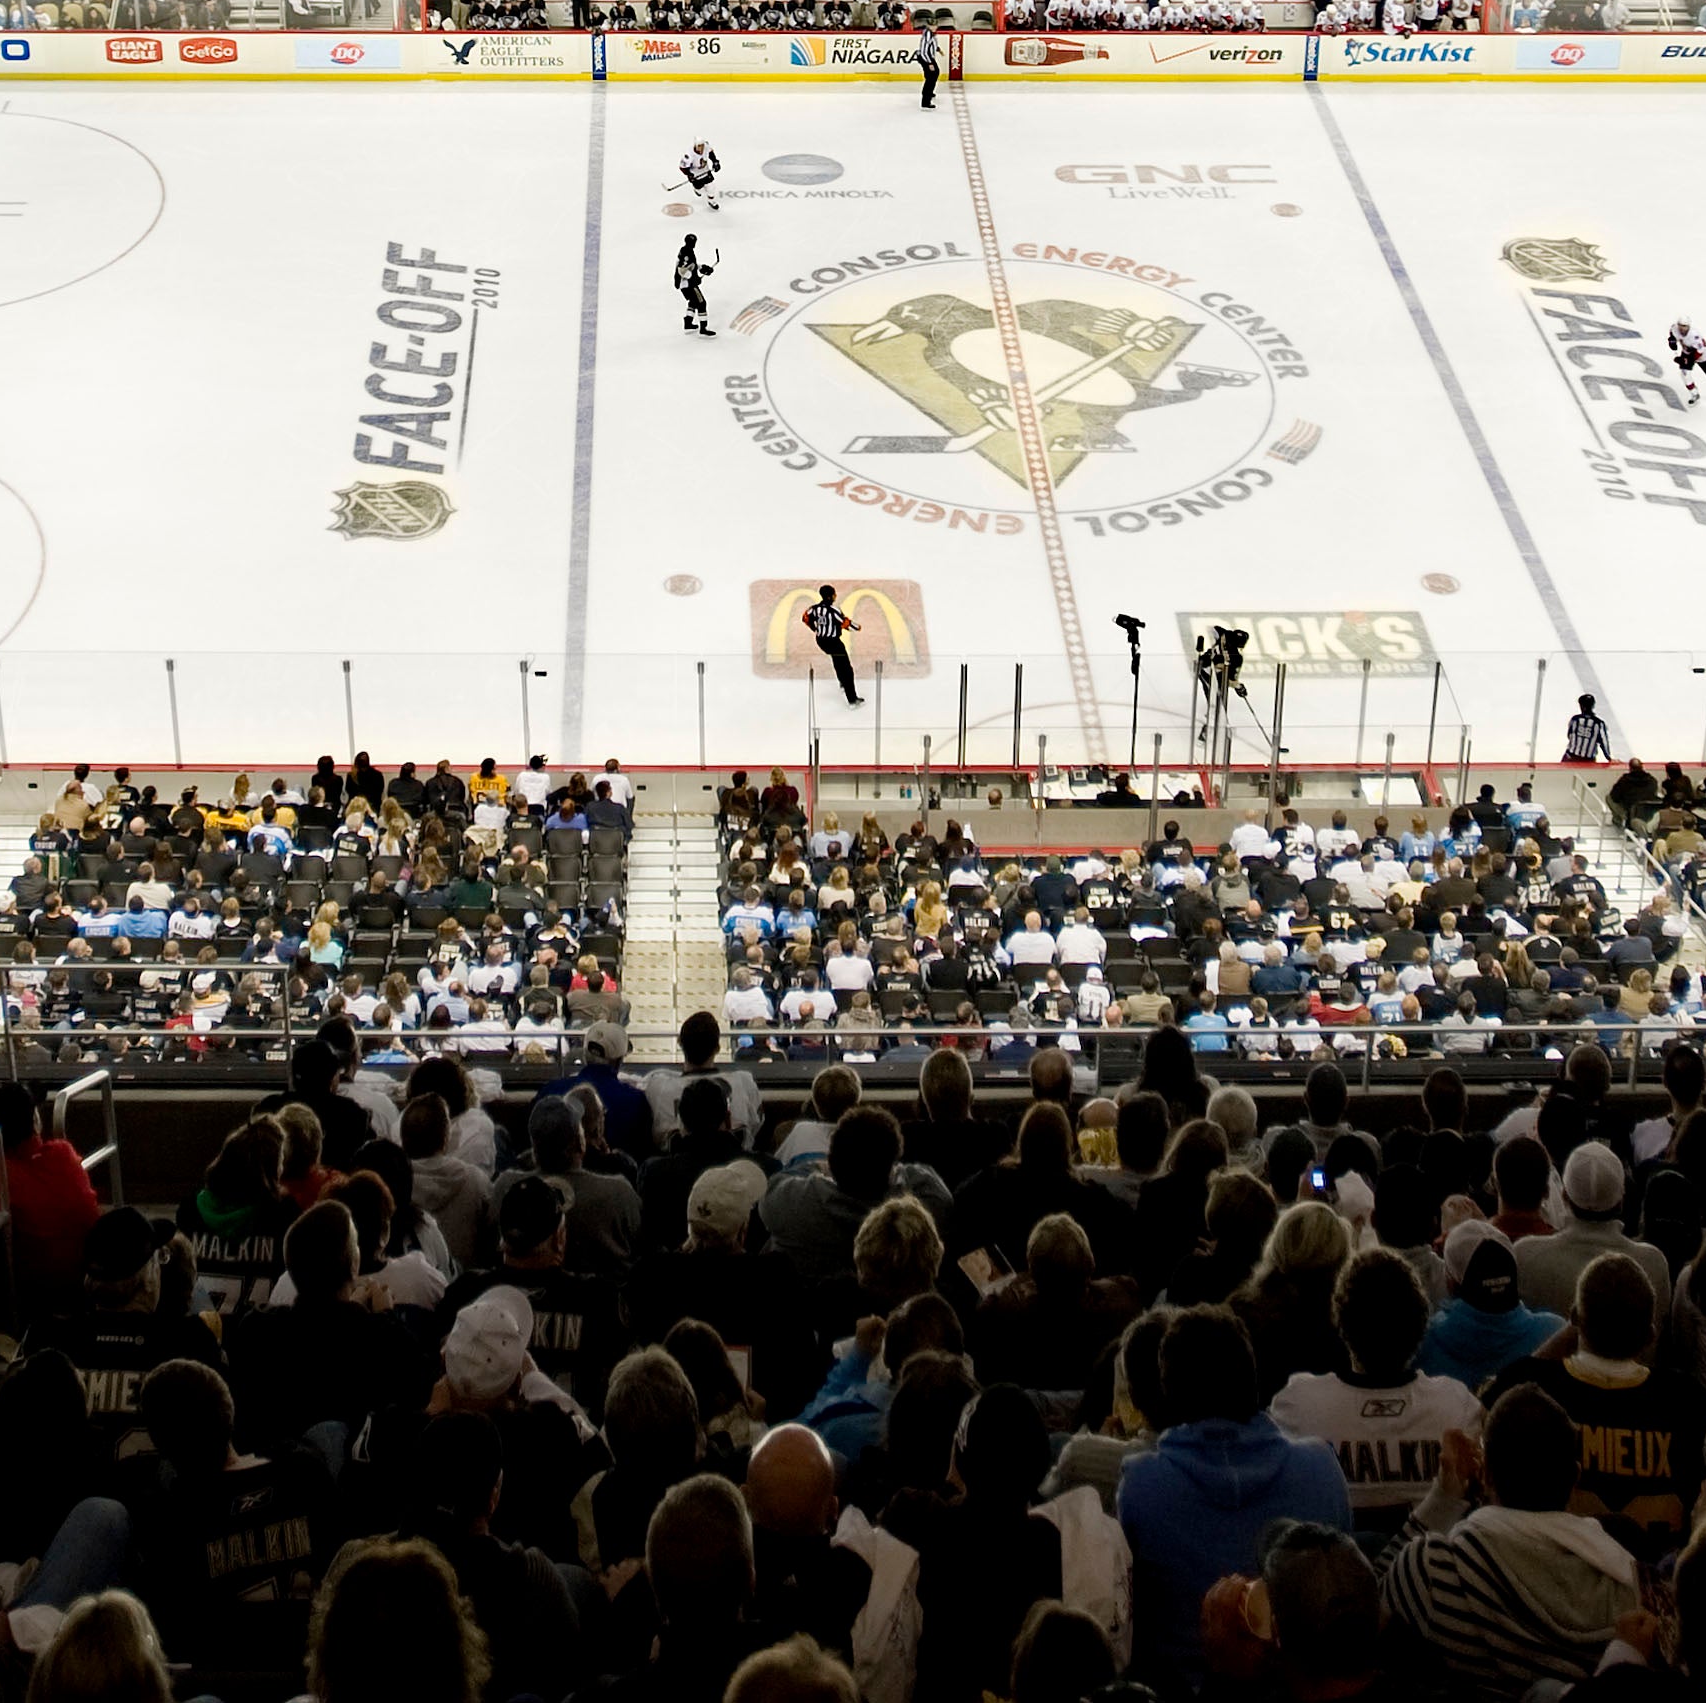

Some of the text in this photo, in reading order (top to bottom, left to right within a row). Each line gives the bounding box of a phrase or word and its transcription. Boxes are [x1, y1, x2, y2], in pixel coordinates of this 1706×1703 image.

[109, 40, 157, 52] GIANT
[480, 36, 553, 46] AMERICAN
[833, 38, 871, 48] FIRST
[111, 49, 157, 61] EAGLE
[181, 43, 235, 60] GetGo
[480, 46, 524, 57] EAGLE
[831, 49, 921, 65] NIAGARA
[1208, 46, 1283, 64] verizon
[1362, 41, 1476, 63] StarKist
[480, 56, 565, 67] OUTFITTERS
[1054, 164, 1278, 186] GNC
[801, 188, 895, 202] MINOLTA
[472, 265, 504, 311] 2010
[789, 240, 1314, 384] CONSOL ENERGY CENTER
[353, 241, 472, 476] FACE-OFF
[725, 373, 1276, 536] CONSOL ENERGY CENTER
[1581, 448, 1635, 502] 2010
[192, 1234, 276, 1265] MALKIN
[204, 1515, 312, 1579] MALKIN
